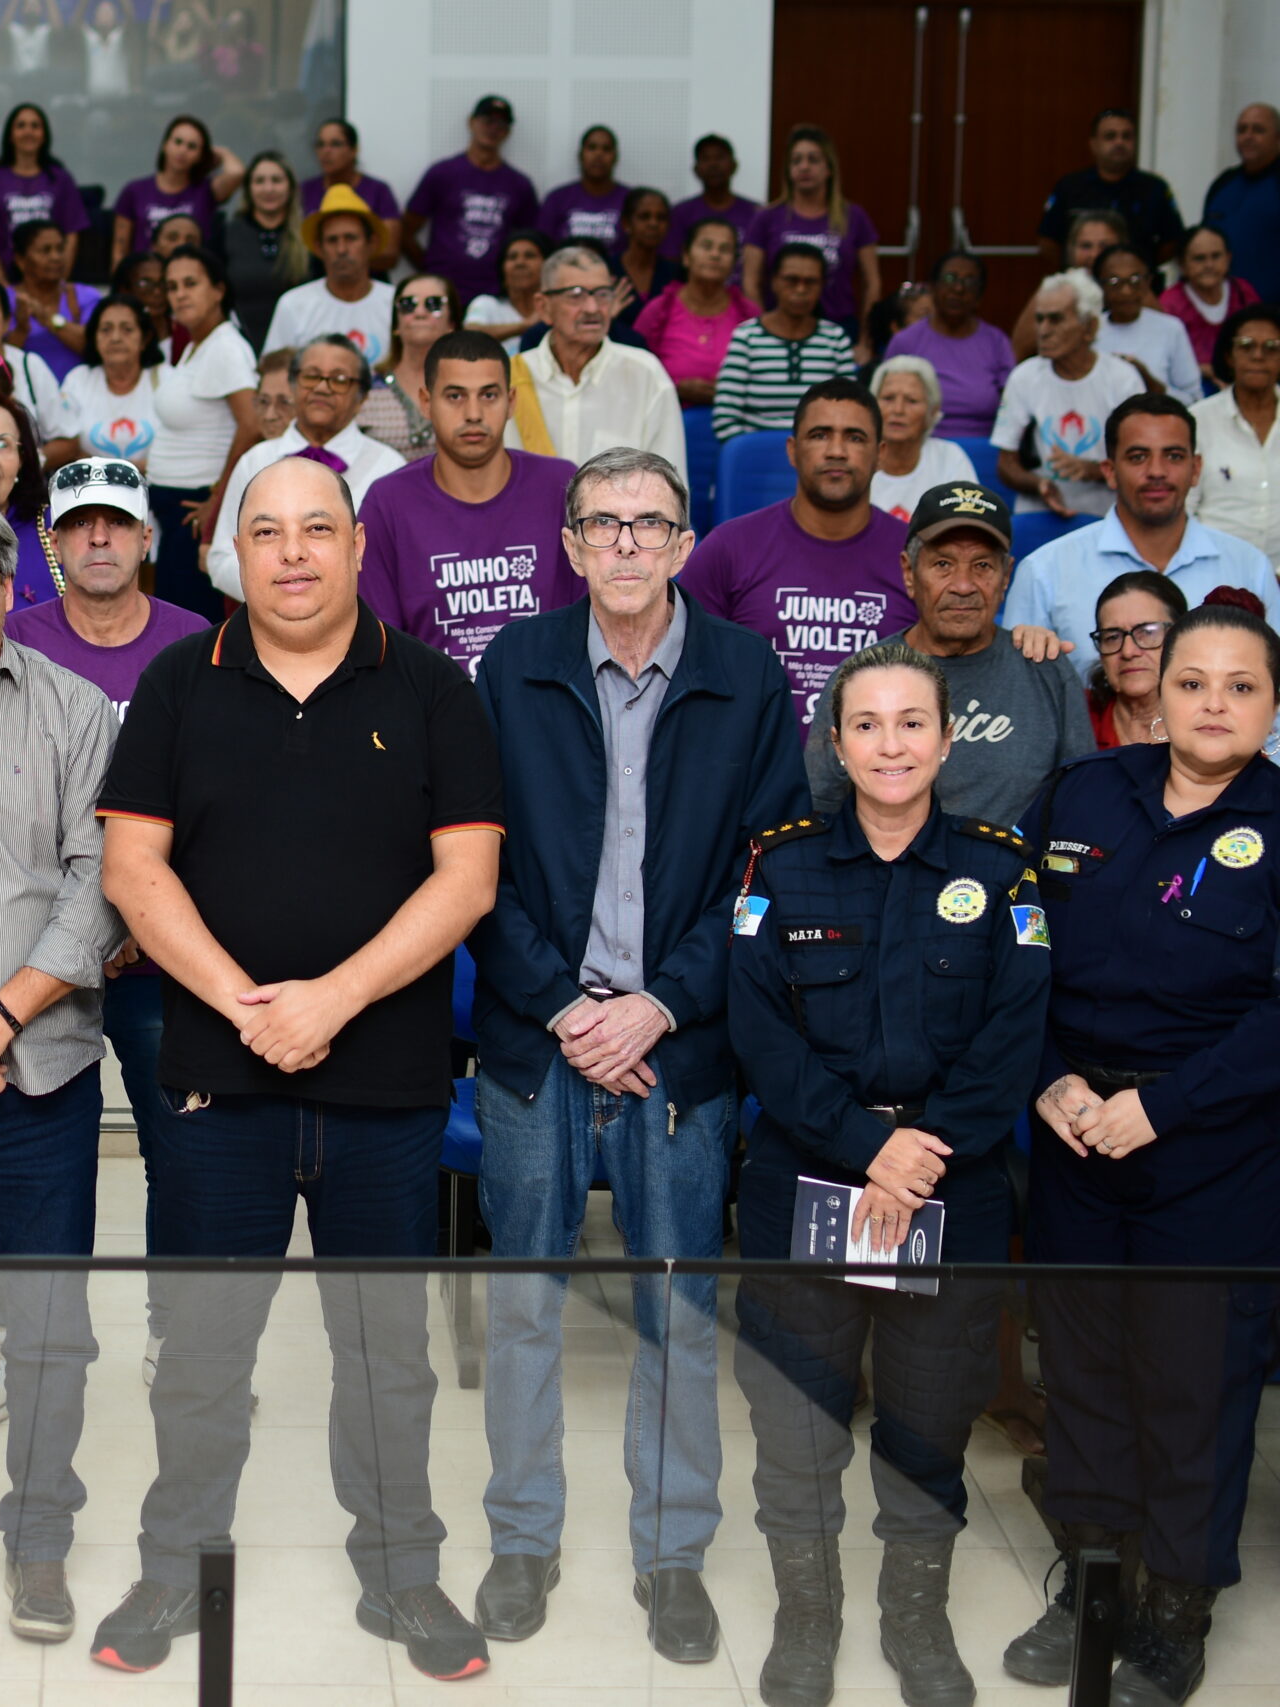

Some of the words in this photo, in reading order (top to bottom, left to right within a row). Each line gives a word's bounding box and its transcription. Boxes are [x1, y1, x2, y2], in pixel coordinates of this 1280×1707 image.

[436, 556, 510, 589] JUNHO
[446, 584, 536, 616] VIOLETA
[778, 596, 857, 624] JUNHO
[786, 624, 879, 653] VIOLETA
[949, 698, 1015, 743] ice
[788, 928, 823, 942] MATA
